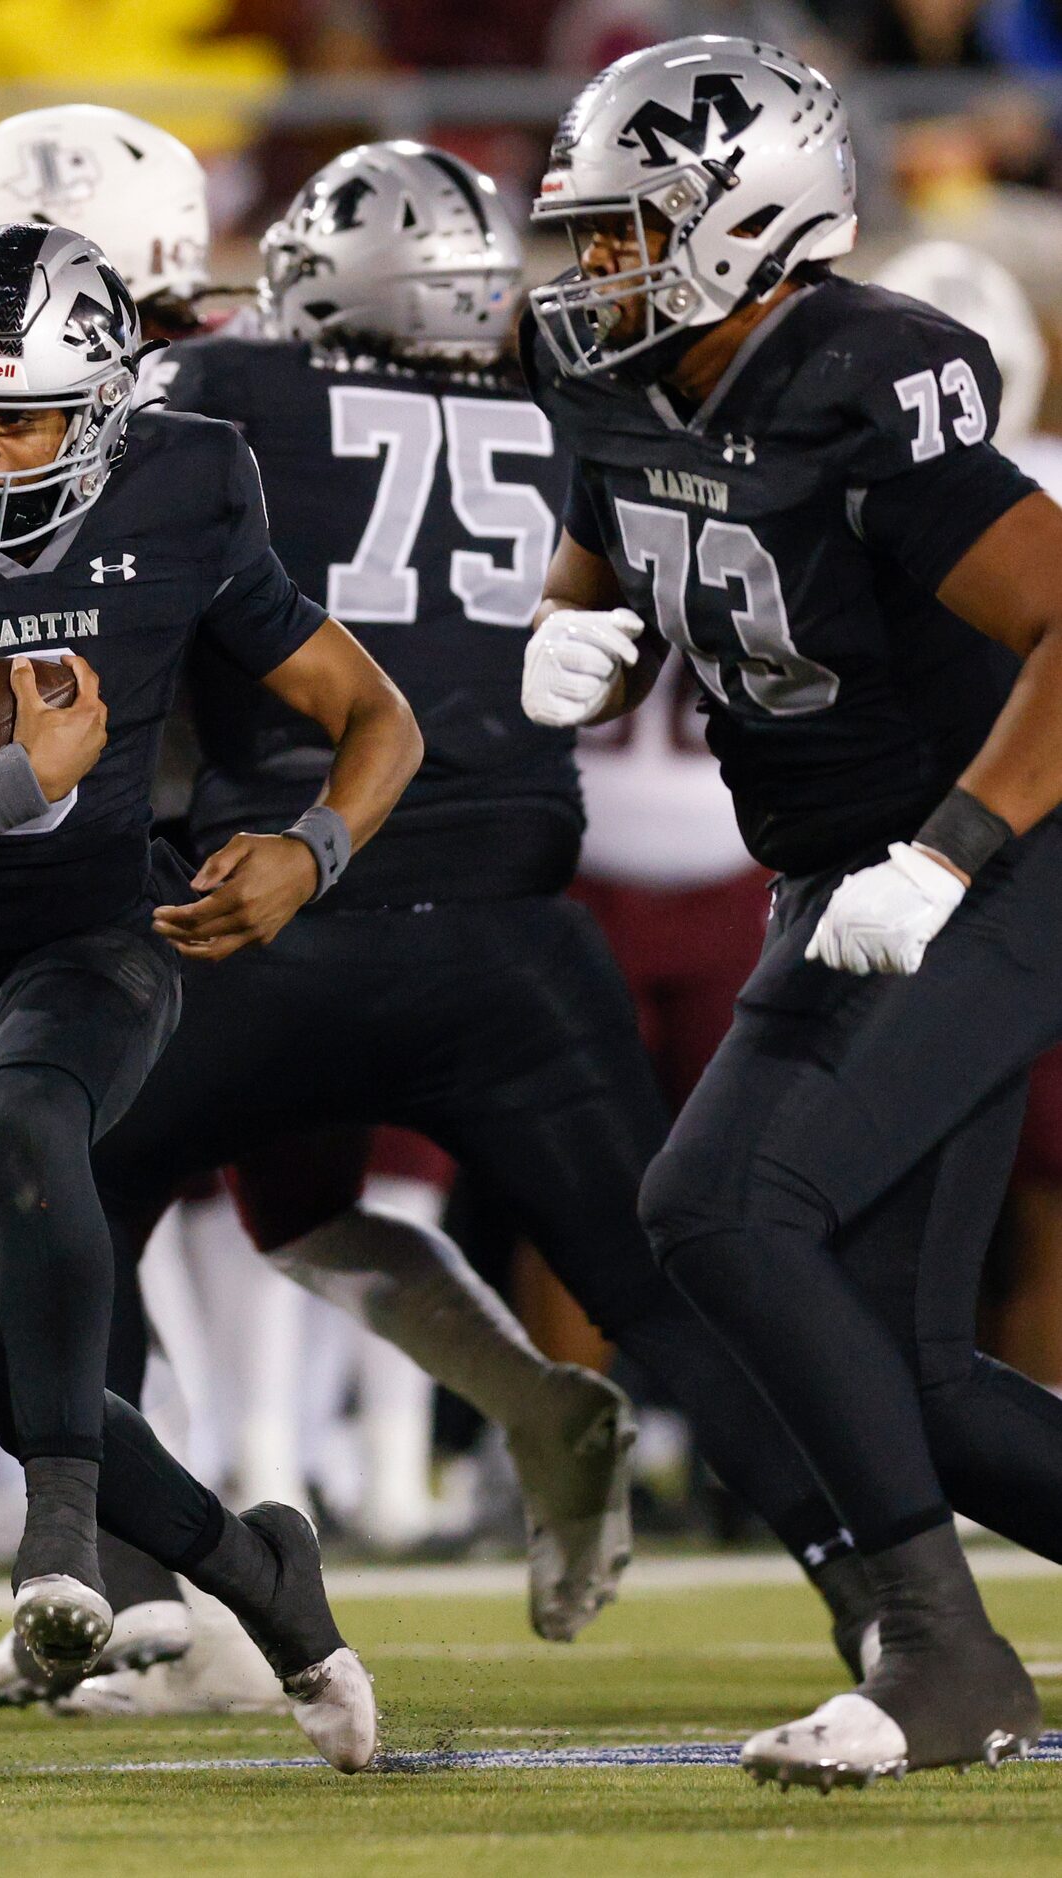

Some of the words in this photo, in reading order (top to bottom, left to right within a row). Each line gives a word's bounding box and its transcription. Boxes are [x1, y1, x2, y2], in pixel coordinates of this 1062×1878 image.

[617, 73, 764, 168] M
[893, 358, 988, 463] 73
[327, 385, 556, 628] 75
[644, 466, 729, 514] MARTIN
[613, 497, 841, 716] 73
